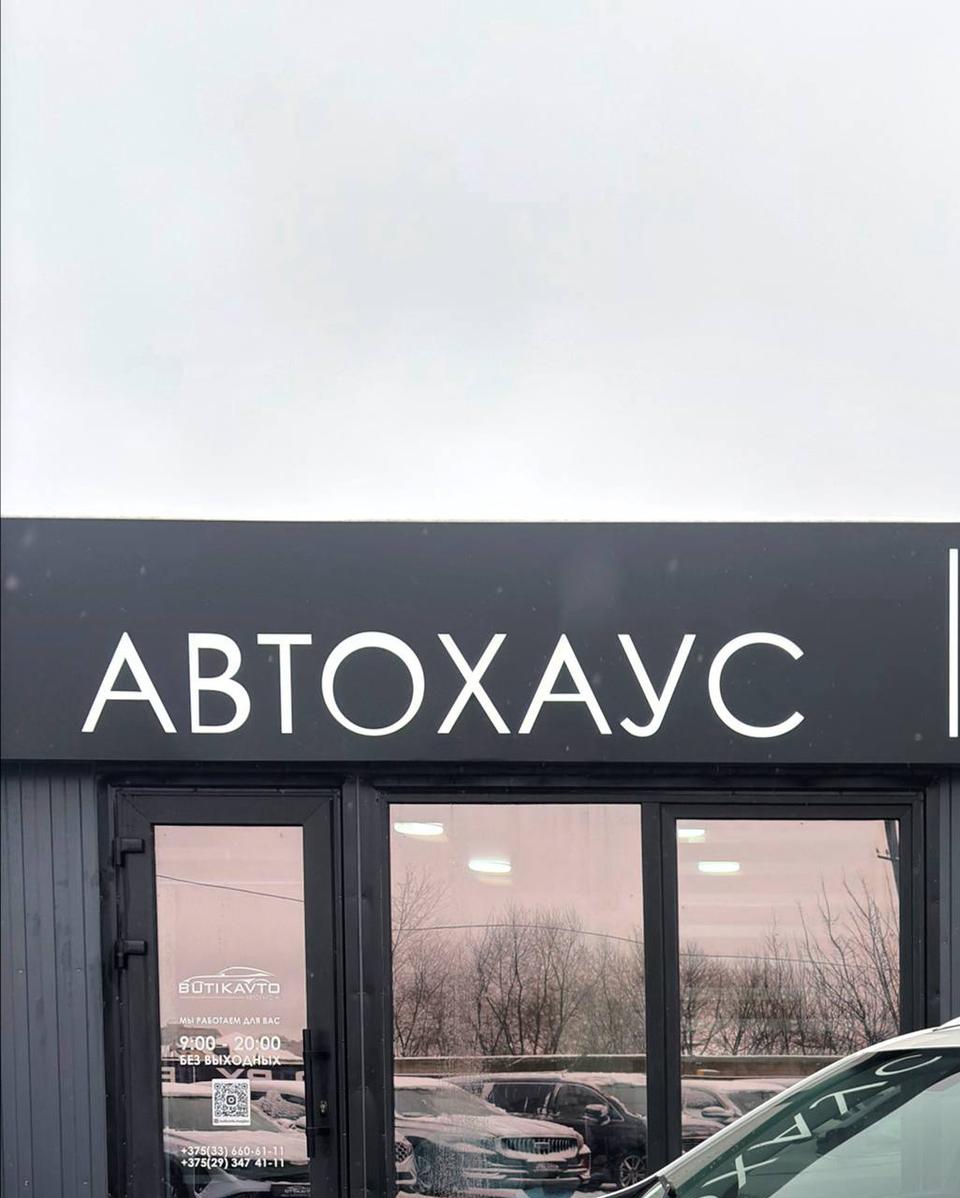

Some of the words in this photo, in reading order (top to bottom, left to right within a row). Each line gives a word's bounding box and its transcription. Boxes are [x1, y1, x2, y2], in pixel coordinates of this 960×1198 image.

[80, 631, 806, 738] АВТОХАУС
[178, 982, 281, 995] BUTIKAVTO
[179, 1016, 195, 1025] МЫ
[196, 1016, 241, 1025] РАБОТАЕМ
[243, 1016, 261, 1026] ДЛЯ
[262, 1016, 281, 1025] ВАС
[179, 1035, 216, 1051] 9:00
[234, 1035, 281, 1051] 20:00
[179, 1054, 201, 1066] БЕЗ
[204, 1054, 281, 1068] ВЫХОДНЫХ
[180, 1145, 228, 1158] +375(33)
[180, 1157, 229, 1170] +375(29)
[231, 1157, 251, 1168] 347
[254, 1157, 285, 1168] 41-11
